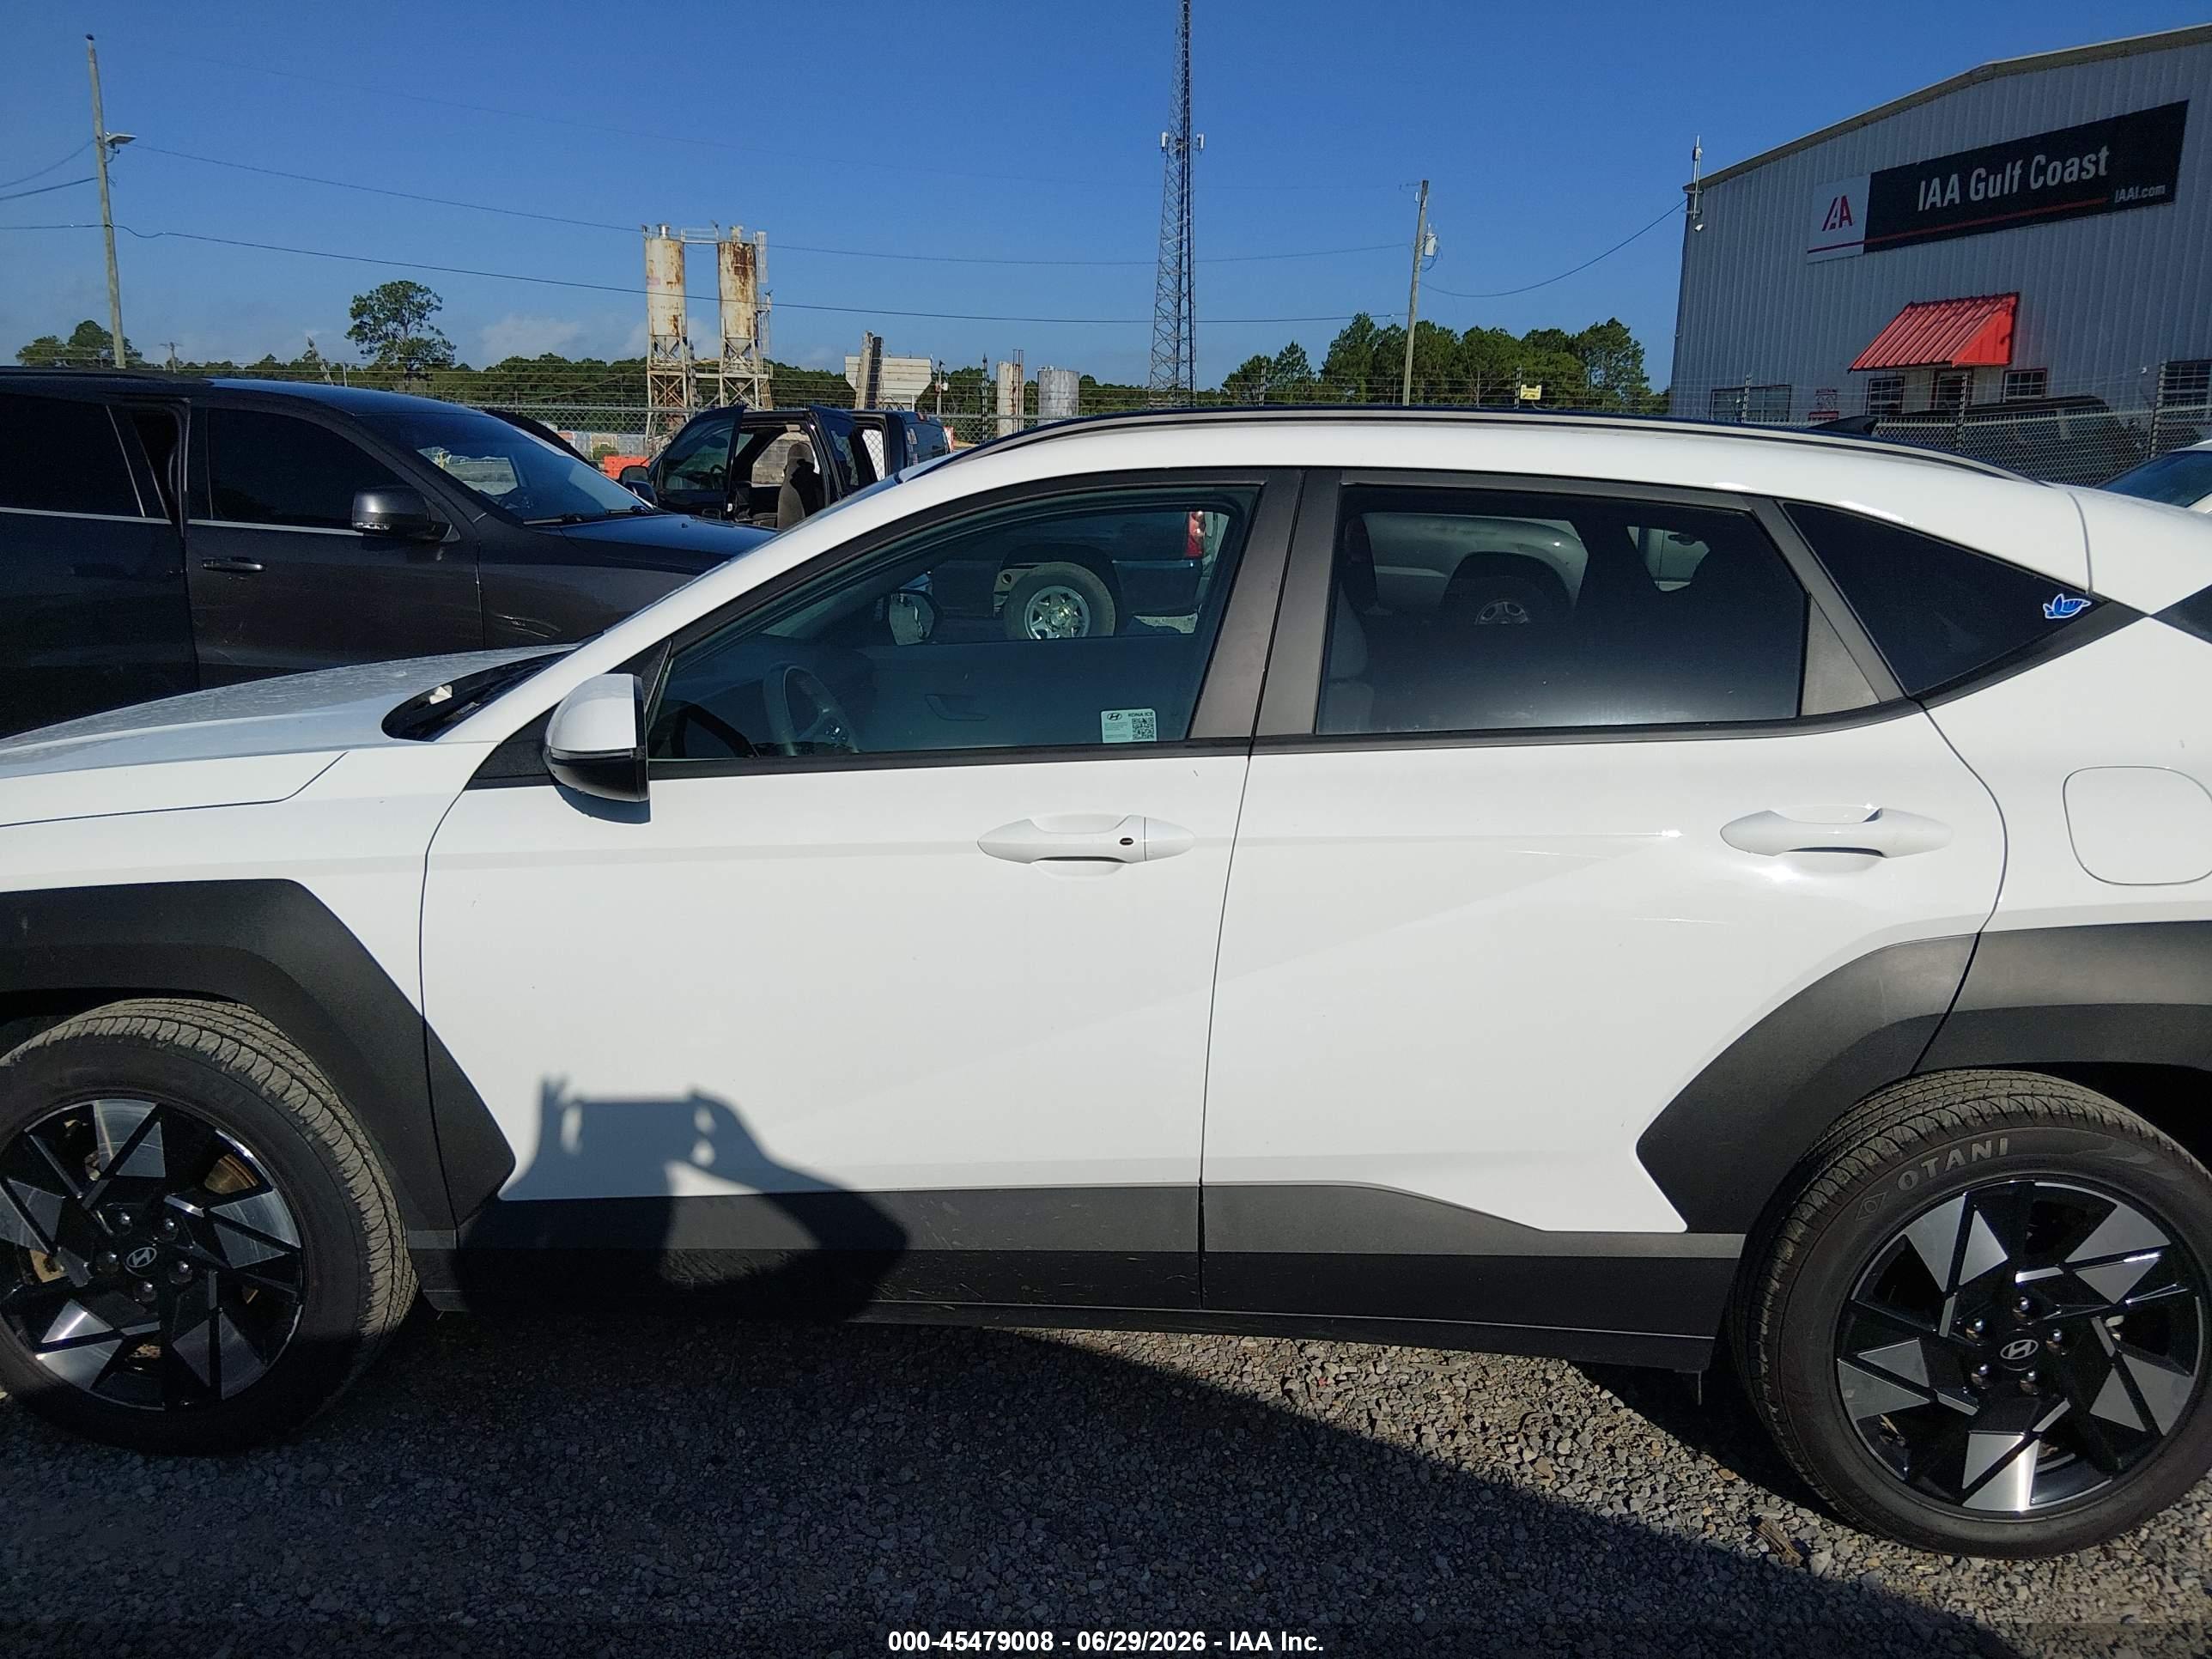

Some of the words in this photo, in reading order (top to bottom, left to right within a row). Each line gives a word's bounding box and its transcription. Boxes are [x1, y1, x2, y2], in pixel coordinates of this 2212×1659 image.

[1917, 173, 1960, 212] IAA
[1969, 159, 2024, 201] Gulf
[2029, 145, 2110, 190] Coast
[1897, 1137, 2008, 1191] OTANI
